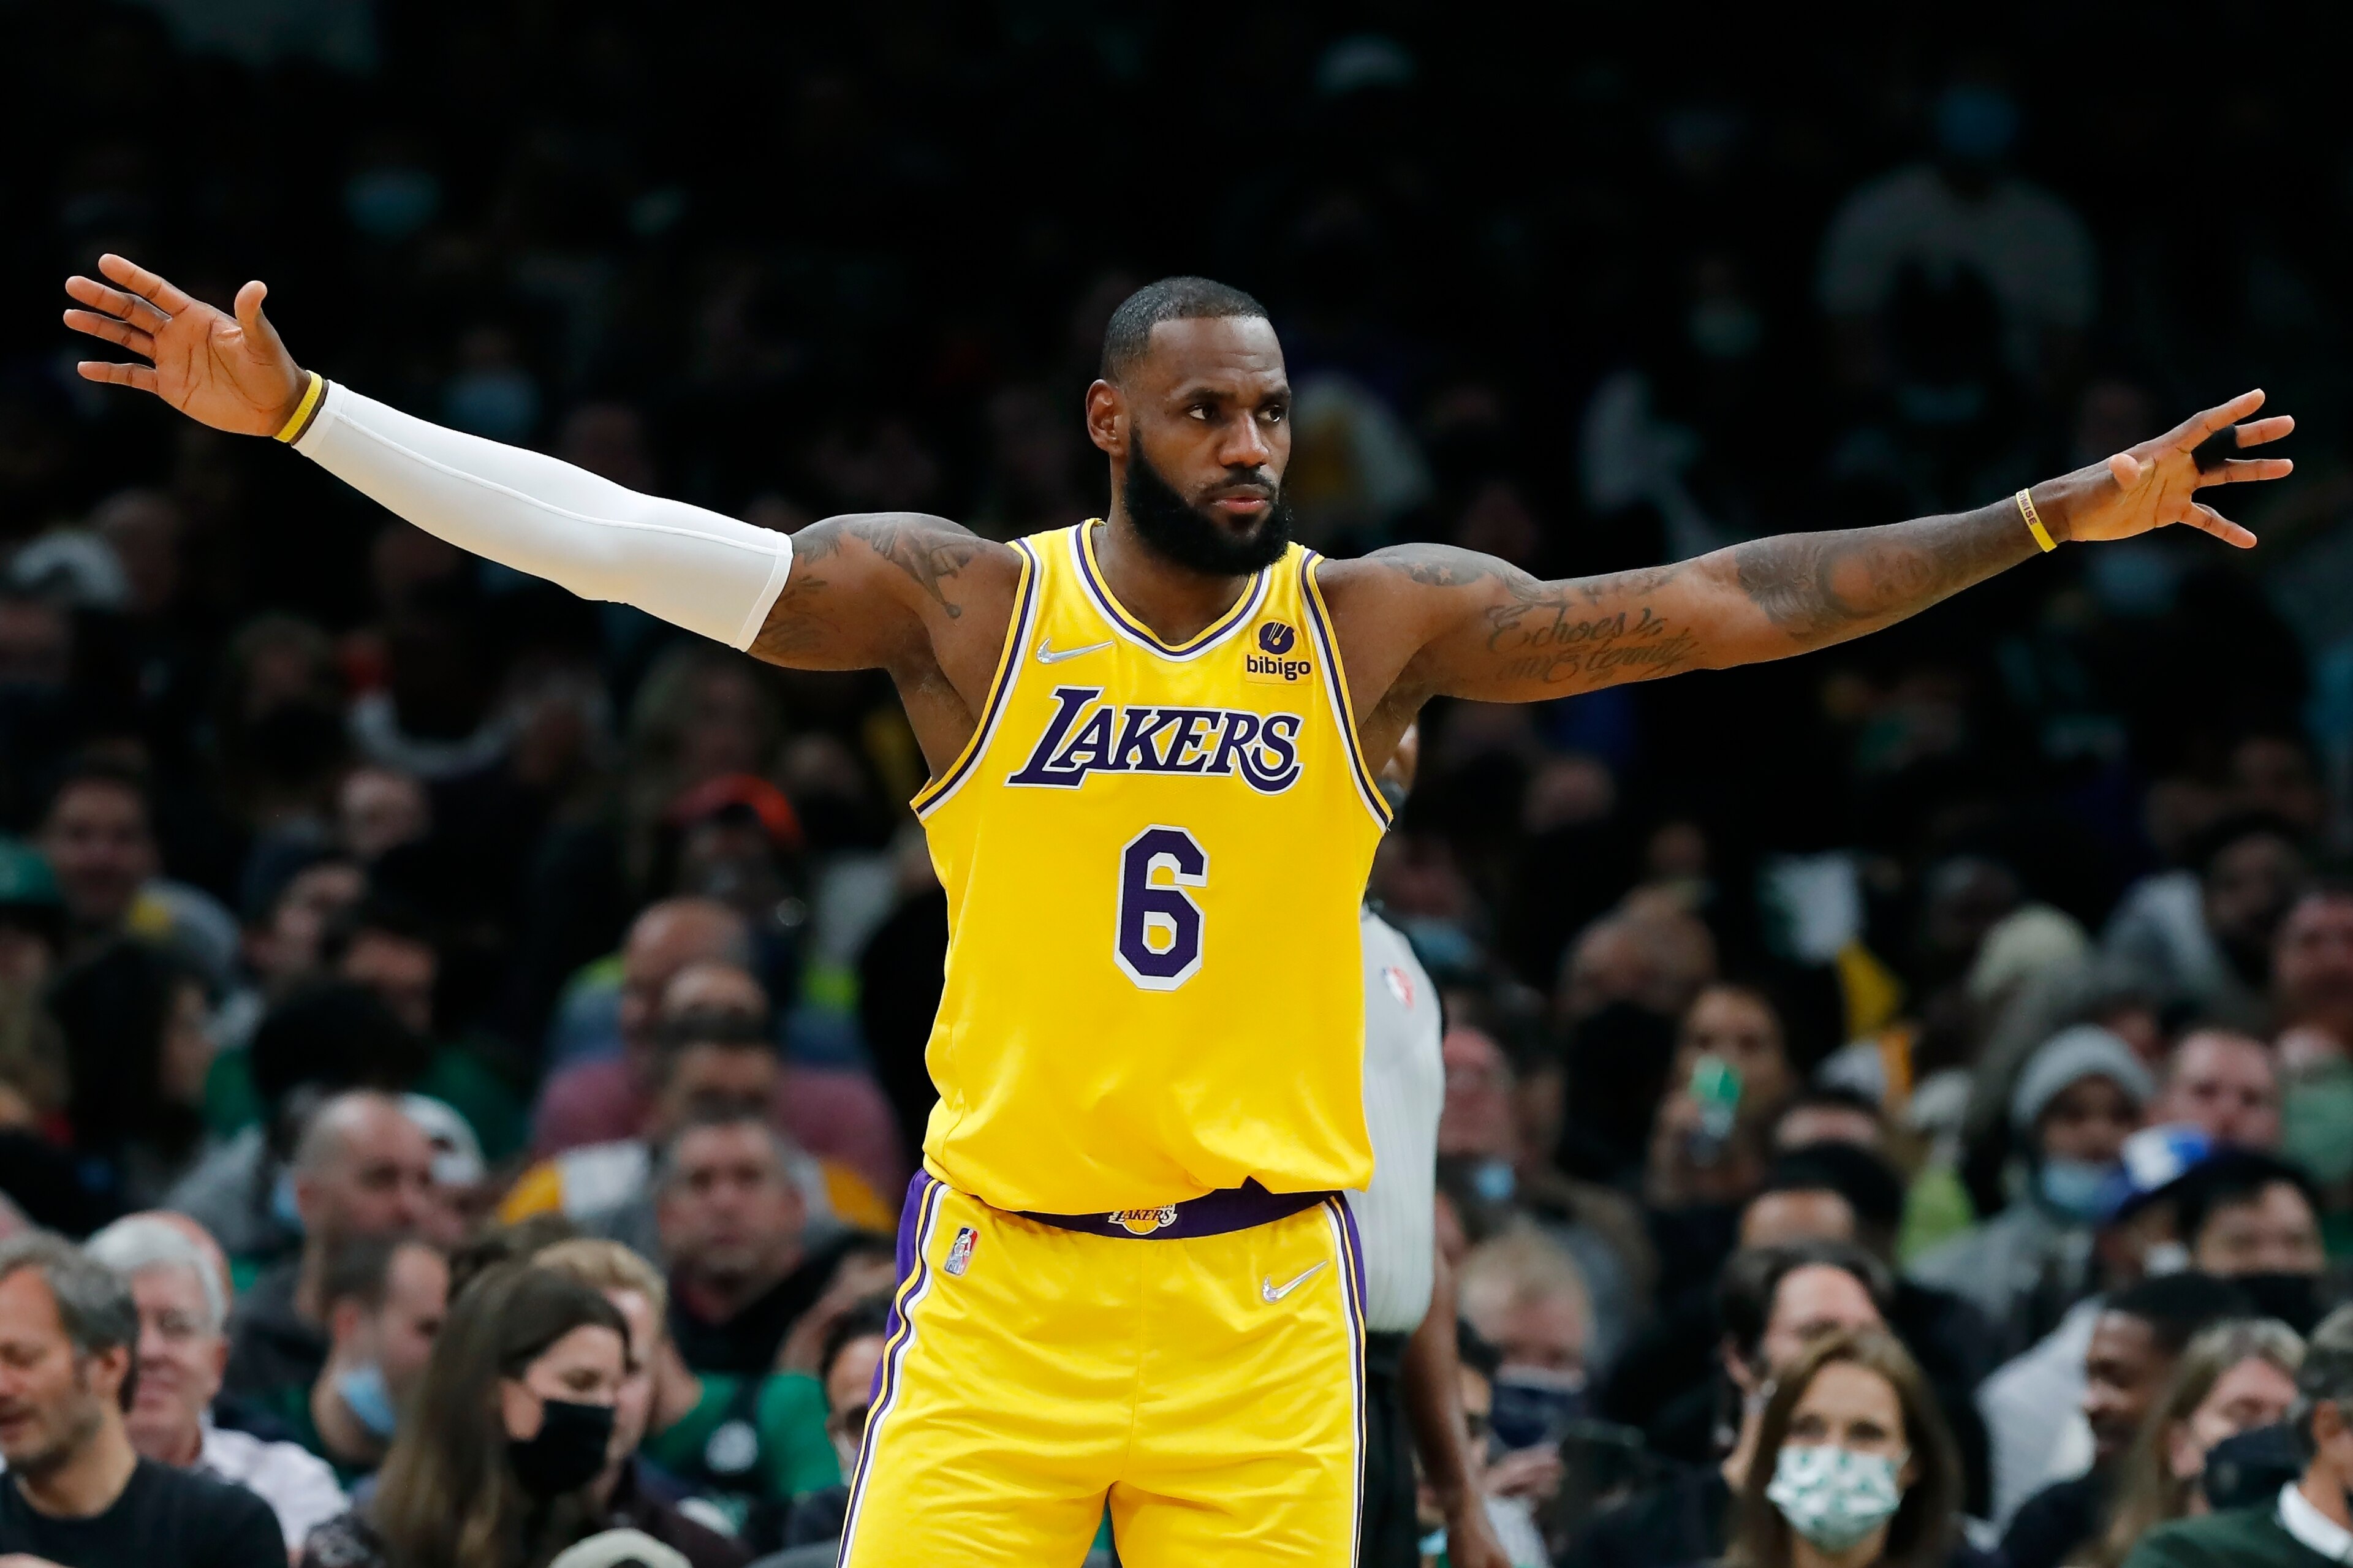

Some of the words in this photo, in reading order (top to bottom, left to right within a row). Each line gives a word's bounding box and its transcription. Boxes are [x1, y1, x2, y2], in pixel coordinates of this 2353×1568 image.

[1246, 654, 1311, 681] bibigo
[1003, 684, 1305, 795] LAKERS
[1113, 824, 1210, 991] 6
[1112, 1208, 1175, 1225] LAKERS
